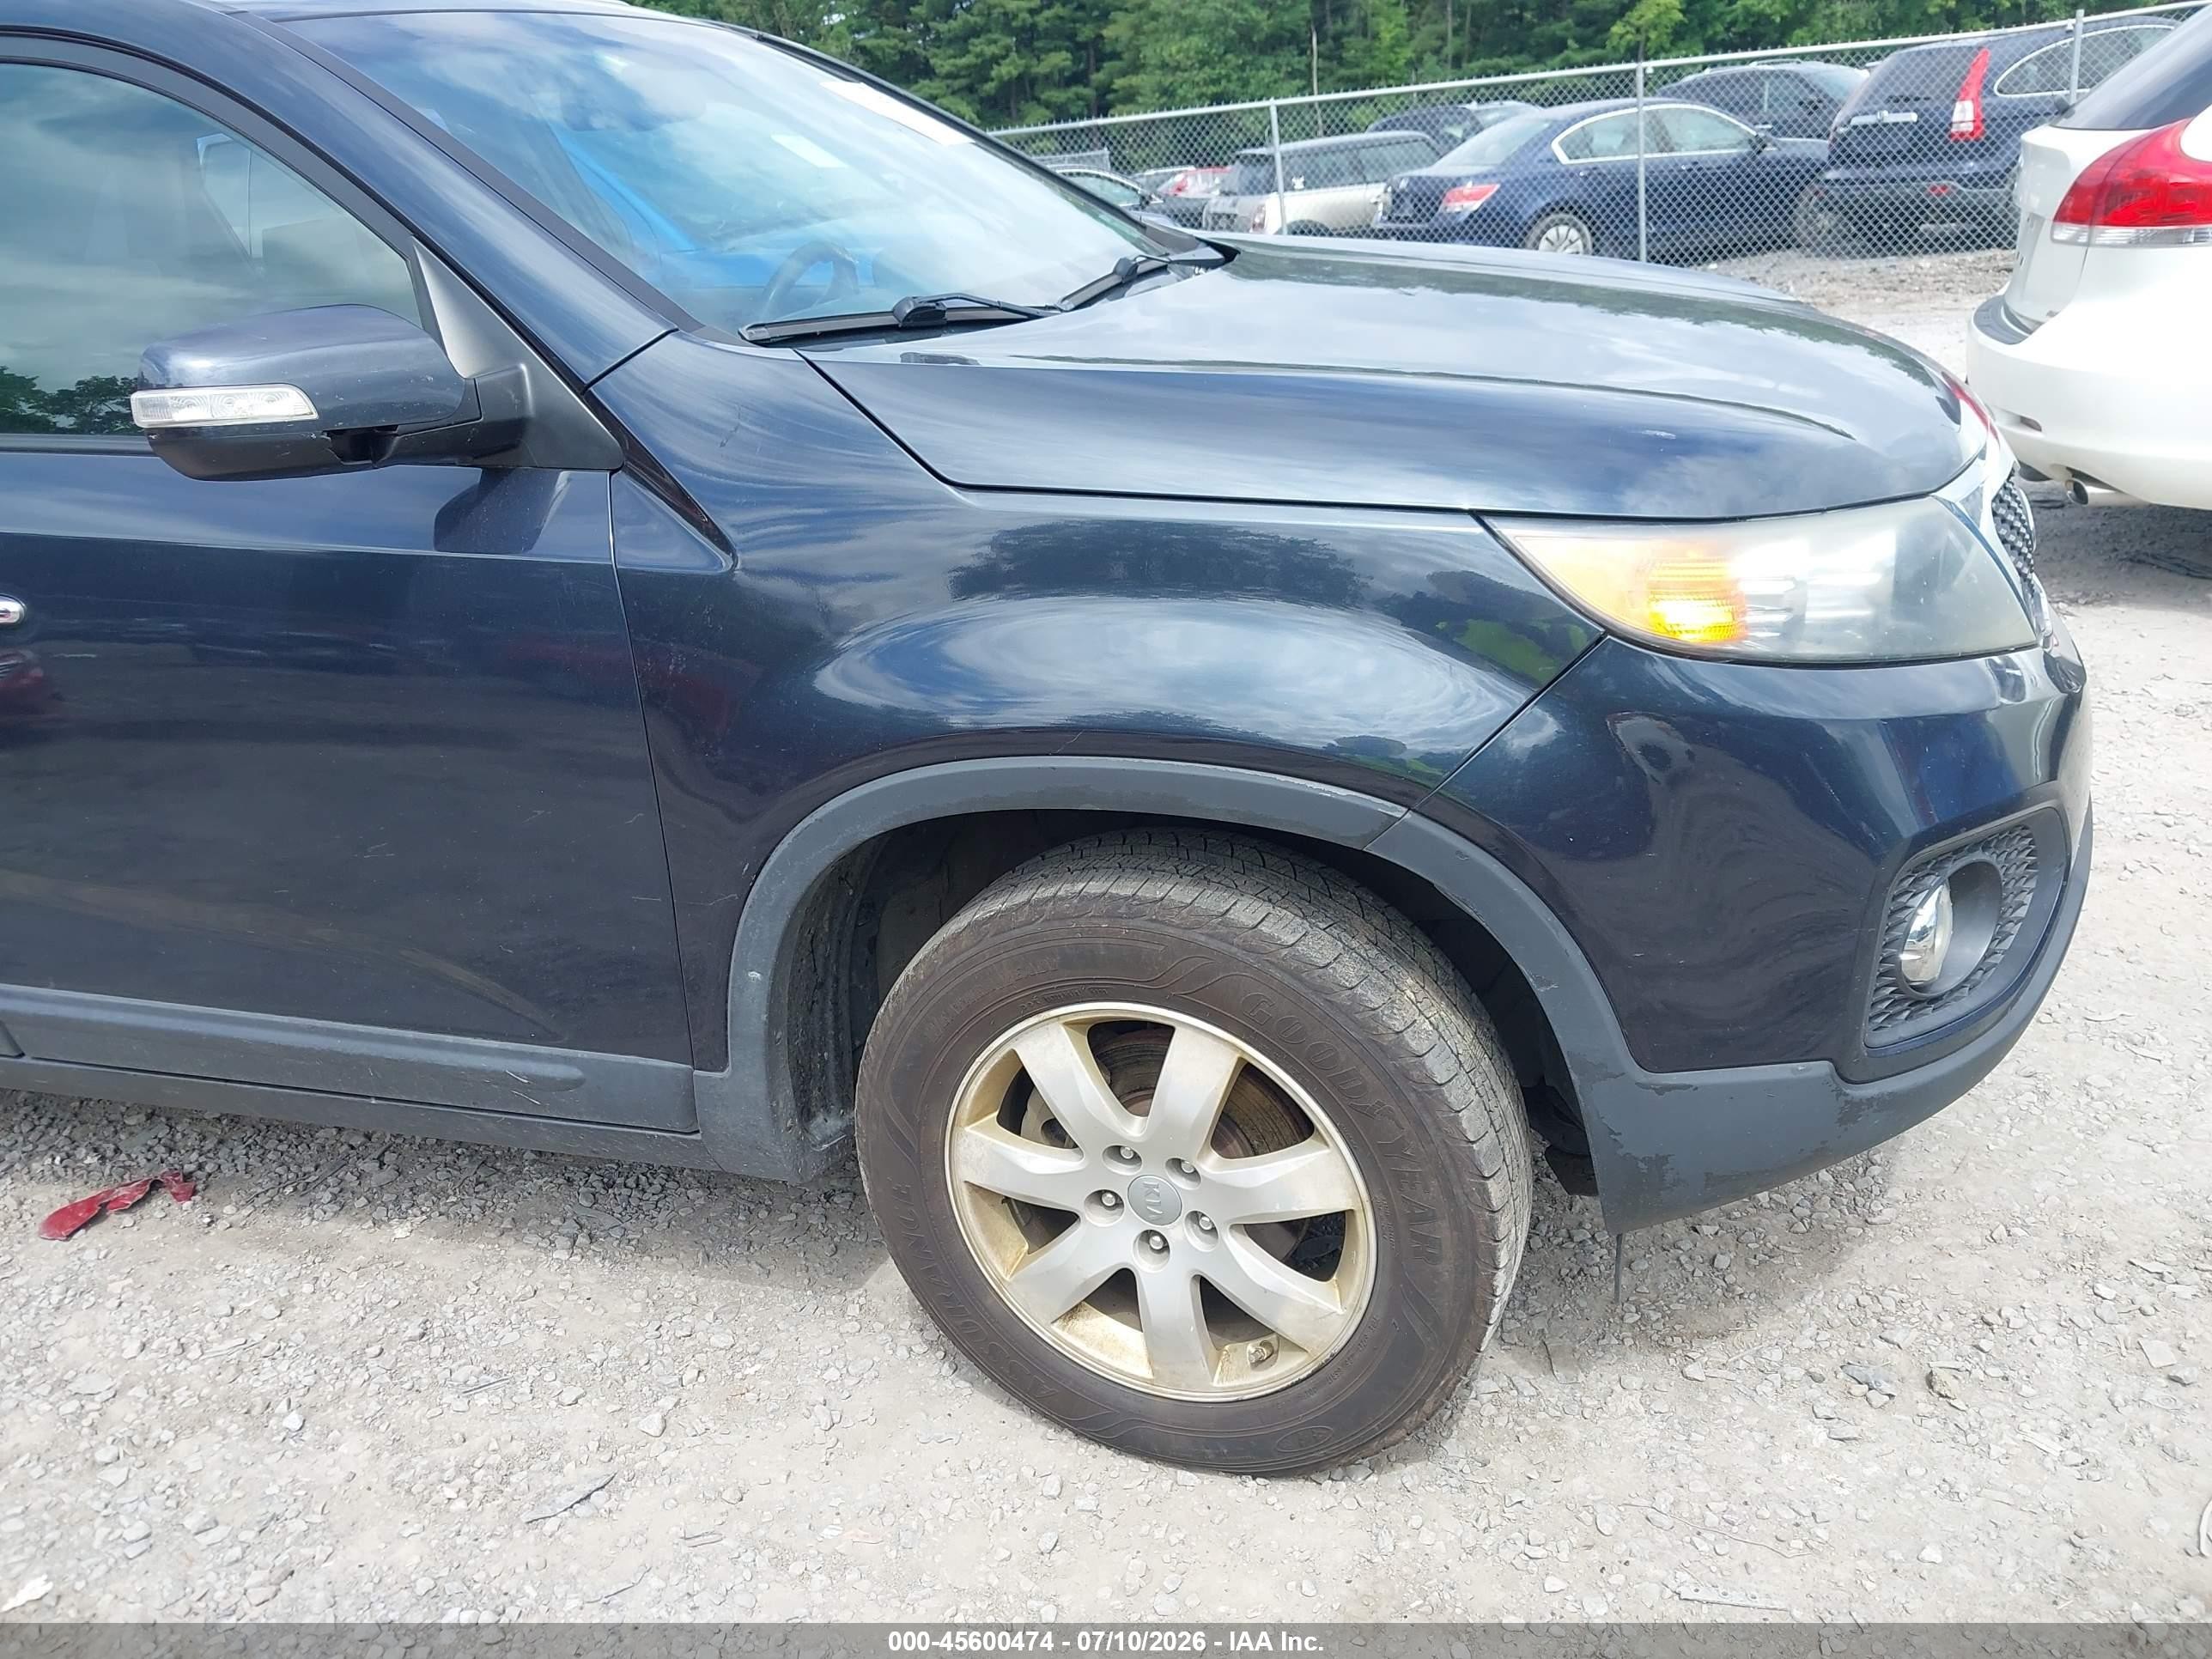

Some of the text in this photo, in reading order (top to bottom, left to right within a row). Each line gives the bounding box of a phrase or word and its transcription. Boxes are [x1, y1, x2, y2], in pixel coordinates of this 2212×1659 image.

[1142, 1180, 1164, 1222] KIA
[1241, 993, 1442, 1266] GOODYEAR
[892, 1181, 1060, 1400] ASSURANCE
